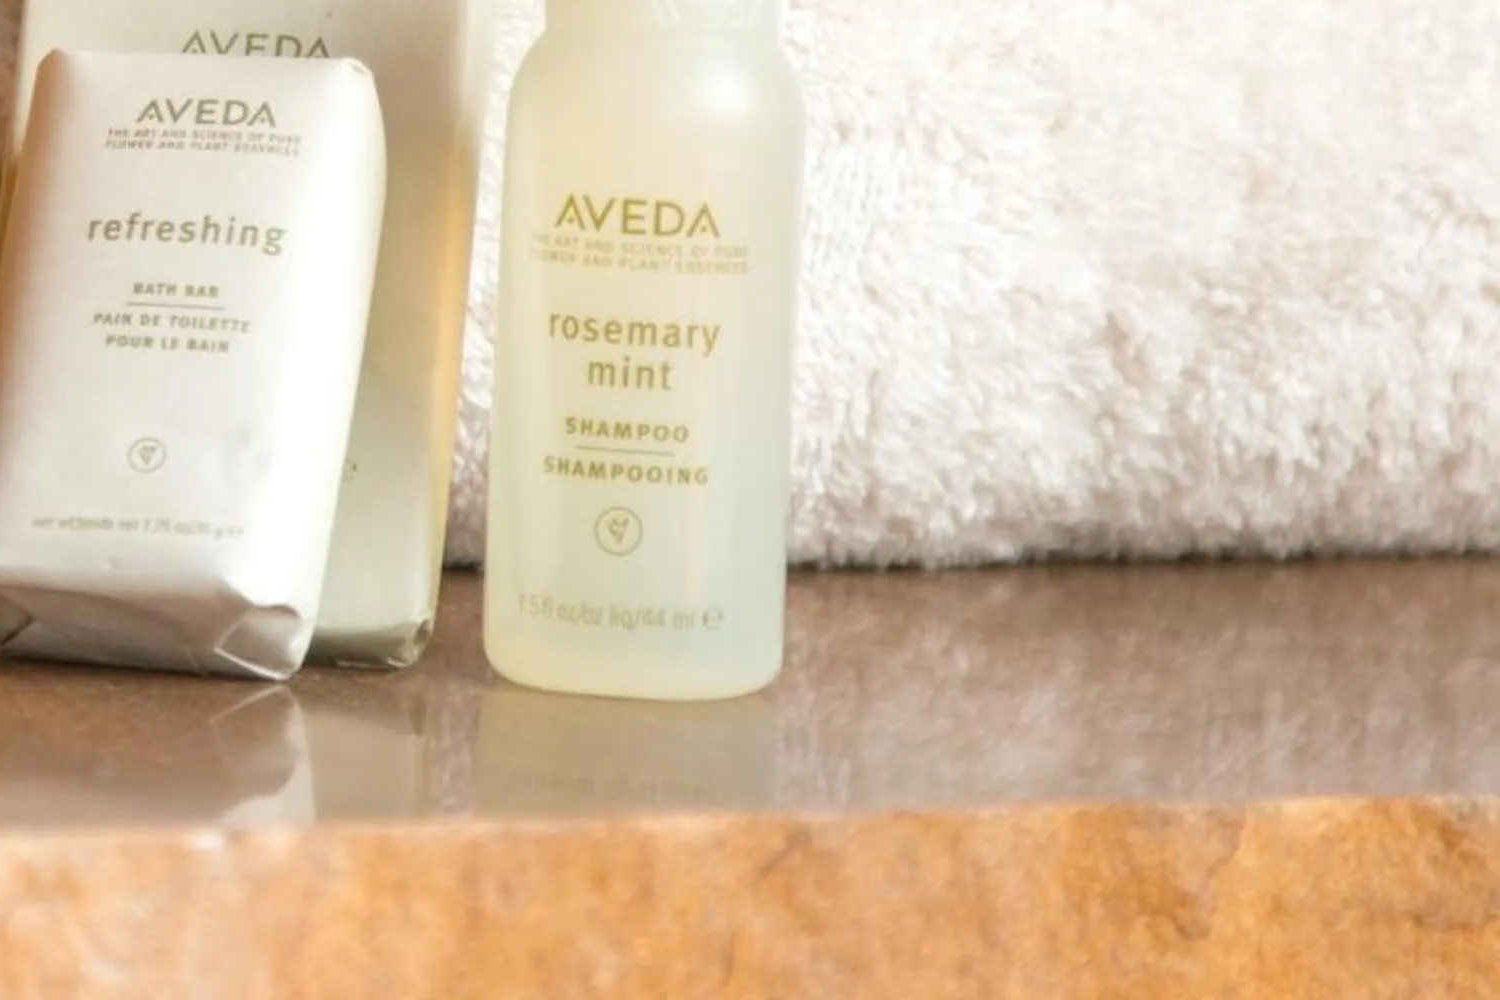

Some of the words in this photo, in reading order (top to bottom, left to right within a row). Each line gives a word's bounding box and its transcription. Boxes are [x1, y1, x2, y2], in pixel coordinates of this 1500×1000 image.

[180, 28, 331, 59] AVEDA
[136, 98, 277, 129] AVEDA
[553, 193, 722, 239] AVEDA
[88, 210, 288, 256] refreshing
[133, 281, 178, 297] BATH
[183, 284, 220, 299] BAR
[93, 312, 133, 326] PAIN
[139, 313, 162, 328] DE
[168, 314, 252, 334] TOILETTE
[549, 312, 722, 358] rosemary
[104, 334, 154, 350] POUR
[186, 338, 231, 354] BAIN
[587, 355, 673, 391] mint
[565, 416, 690, 443] SHAMPOO
[543, 455, 709, 486] SHAMPOOING
